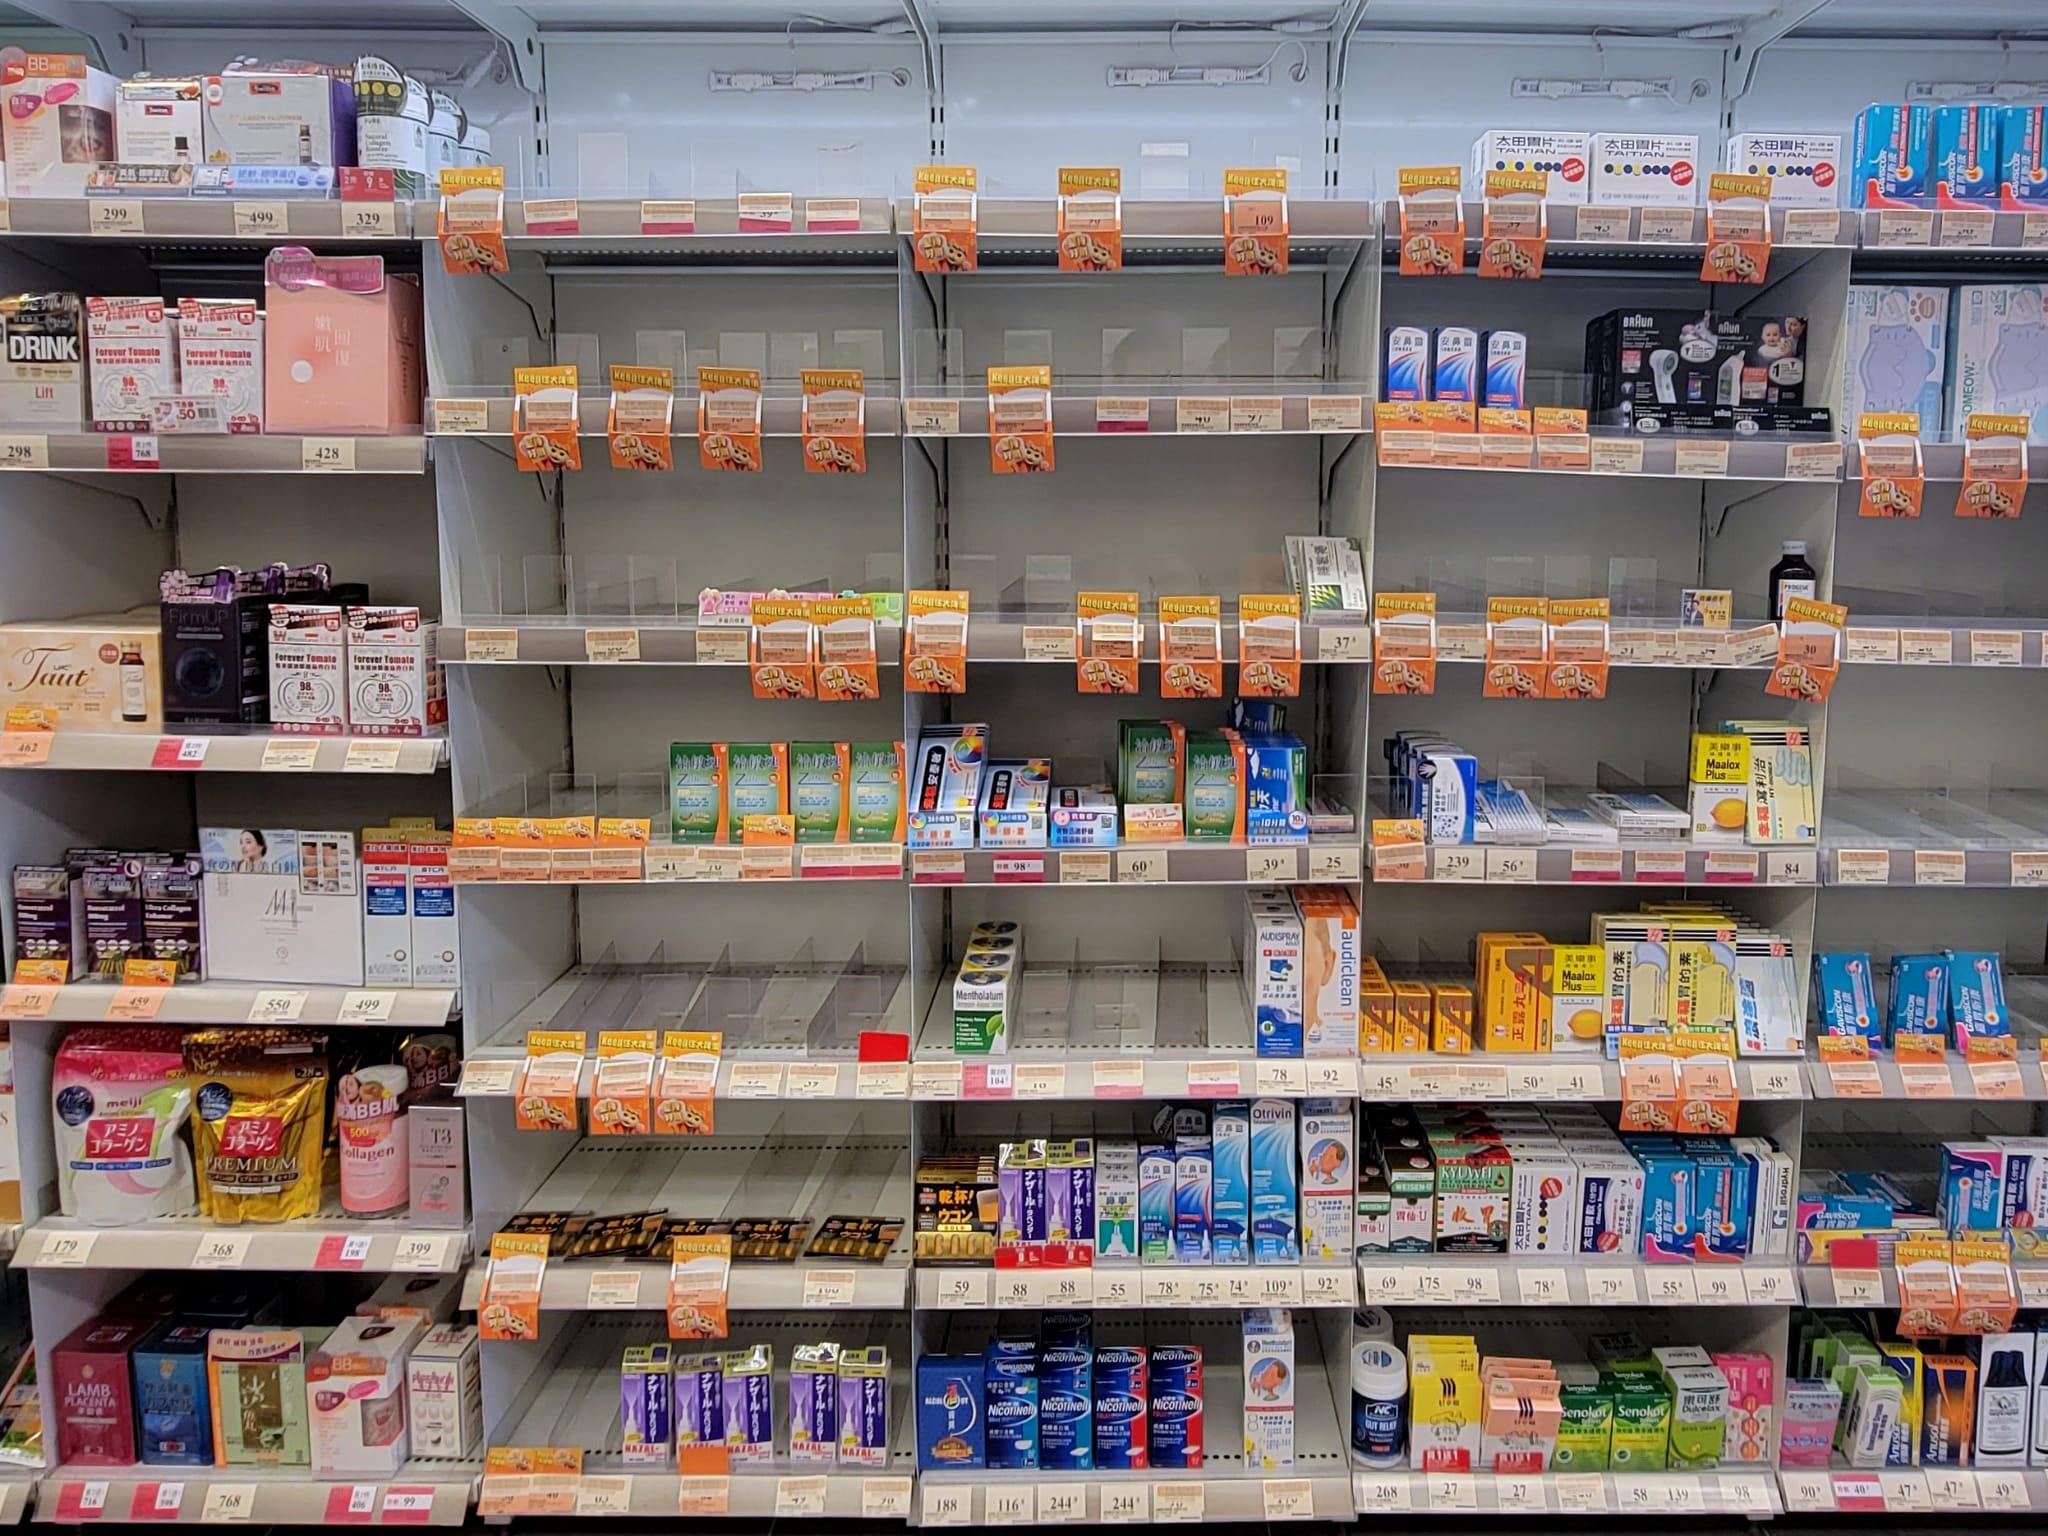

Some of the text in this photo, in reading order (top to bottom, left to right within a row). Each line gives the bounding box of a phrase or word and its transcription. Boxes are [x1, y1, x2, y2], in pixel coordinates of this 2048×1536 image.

[27, 57, 49, 71] BB
[103, 208, 127, 221] 299
[249, 211, 273, 225] 499
[357, 213, 380, 226] 329
[1255, 215, 1273, 227] 109
[1623, 314, 1653, 328] BRAUN
[10, 336, 78, 360] DRINK
[35, 387, 54, 399] Lift
[7, 446, 32, 458] 298
[316, 447, 340, 460] 428
[1334, 636, 1350, 649] 37
[275, 653, 337, 664] Forever Tomato
[354, 654, 415, 664] Forever Tomato
[1706, 759, 1740, 769] Maalox
[1705, 770, 1726, 780] Plus
[1014, 861, 1026, 871] 98
[1132, 860, 1147, 873] 60
[1326, 857, 1341, 869] 25
[1447, 856, 1469, 869] 239
[1785, 863, 1800, 876] 84
[1260, 931, 1300, 941] AUDISPRAY
[1340, 931, 1356, 1007] audiclean
[1562, 970, 1596, 981] Maalox
[1562, 982, 1582, 991] Plus
[956, 989, 1004, 1002] Mentholatum
[266, 999, 290, 1011] 550
[355, 999, 379, 1011] 499
[1960, 986, 1974, 1031] GAVISCON
[1833, 989, 1846, 1036] GAVISCON
[1272, 1068, 1287, 1081] 78
[1323, 1069, 1338, 1082] 92
[1648, 1074, 1660, 1085] 46
[1706, 1074, 1718, 1085] 46
[1377, 1076, 1392, 1089] 45
[1523, 1076, 1538, 1089] 50
[1570, 1076, 1584, 1089] 41
[107, 1096, 142, 1109] meiji
[1253, 1106, 1293, 1121] Otrivin
[104, 1123, 139, 1138] アミノ
[240, 1121, 270, 1135] アミノ
[90, 1138, 147, 1154] コラーゲン
[224, 1136, 276, 1151] コラーゲン
[206, 1157, 297, 1171] PREMIUM
[1780, 1167, 1791, 1206] Hydrosil
[939, 1208, 973, 1224] ウコン
[54, 1241, 77, 1253] 179
[211, 1244, 235, 1256] 368
[407, 1243, 431, 1255] 399
[954, 1281, 969, 1293] 59
[1013, 1283, 1027, 1296] 88
[1060, 1281, 1075, 1293] 88
[1158, 1281, 1173, 1294] 78
[1199, 1283, 1213, 1296] 75
[1230, 1280, 1243, 1292] 74
[1265, 1281, 1287, 1293] 109
[1318, 1278, 1333, 1290] 92
[1382, 1277, 1396, 1289] 69
[1420, 1277, 1440, 1289] 175
[1467, 1277, 1482, 1290] 98
[1534, 1280, 1549, 1293] 78
[1602, 1280, 1617, 1292] 79
[1663, 1281, 1678, 1294] 55
[1712, 1281, 1727, 1294] 99
[1761, 1277, 1776, 1291] 40
[1111, 1284, 1125, 1296] 55
[68, 1382, 111, 1397] LAMB
[64, 1397, 116, 1408] PLACENTA
[1041, 1397, 1089, 1413] Nicotinell
[1096, 1399, 1144, 1412] Nicotinell
[1153, 1398, 1200, 1410] Nicotinell
[988, 1404, 1035, 1416] Nicotinell
[1561, 1405, 1608, 1420] Senokot
[1617, 1406, 1665, 1418] Senokot
[1365, 1419, 1397, 1431] GUT RELIEF
[1925, 1423, 1939, 1462] Anusol
[1376, 1486, 1398, 1499] 268
[1443, 1483, 1458, 1497] 27
[1512, 1485, 1527, 1499] 27
[1735, 1486, 1750, 1499] 98
[1801, 1486, 1815, 1498] 90
[1898, 1484, 1912, 1497] 47
[1944, 1482, 1958, 1494] 47
[1996, 1486, 2009, 1498] 49
[220, 1495, 240, 1507] 768
[403, 1496, 416, 1506] 99
[1633, 1488, 1648, 1502] 58
[1668, 1488, 1689, 1502] 139
[936, 1498, 958, 1512] 188
[998, 1498, 1019, 1512] 116
[1050, 1497, 1073, 1511] 244
[1113, 1497, 1135, 1511] 244
